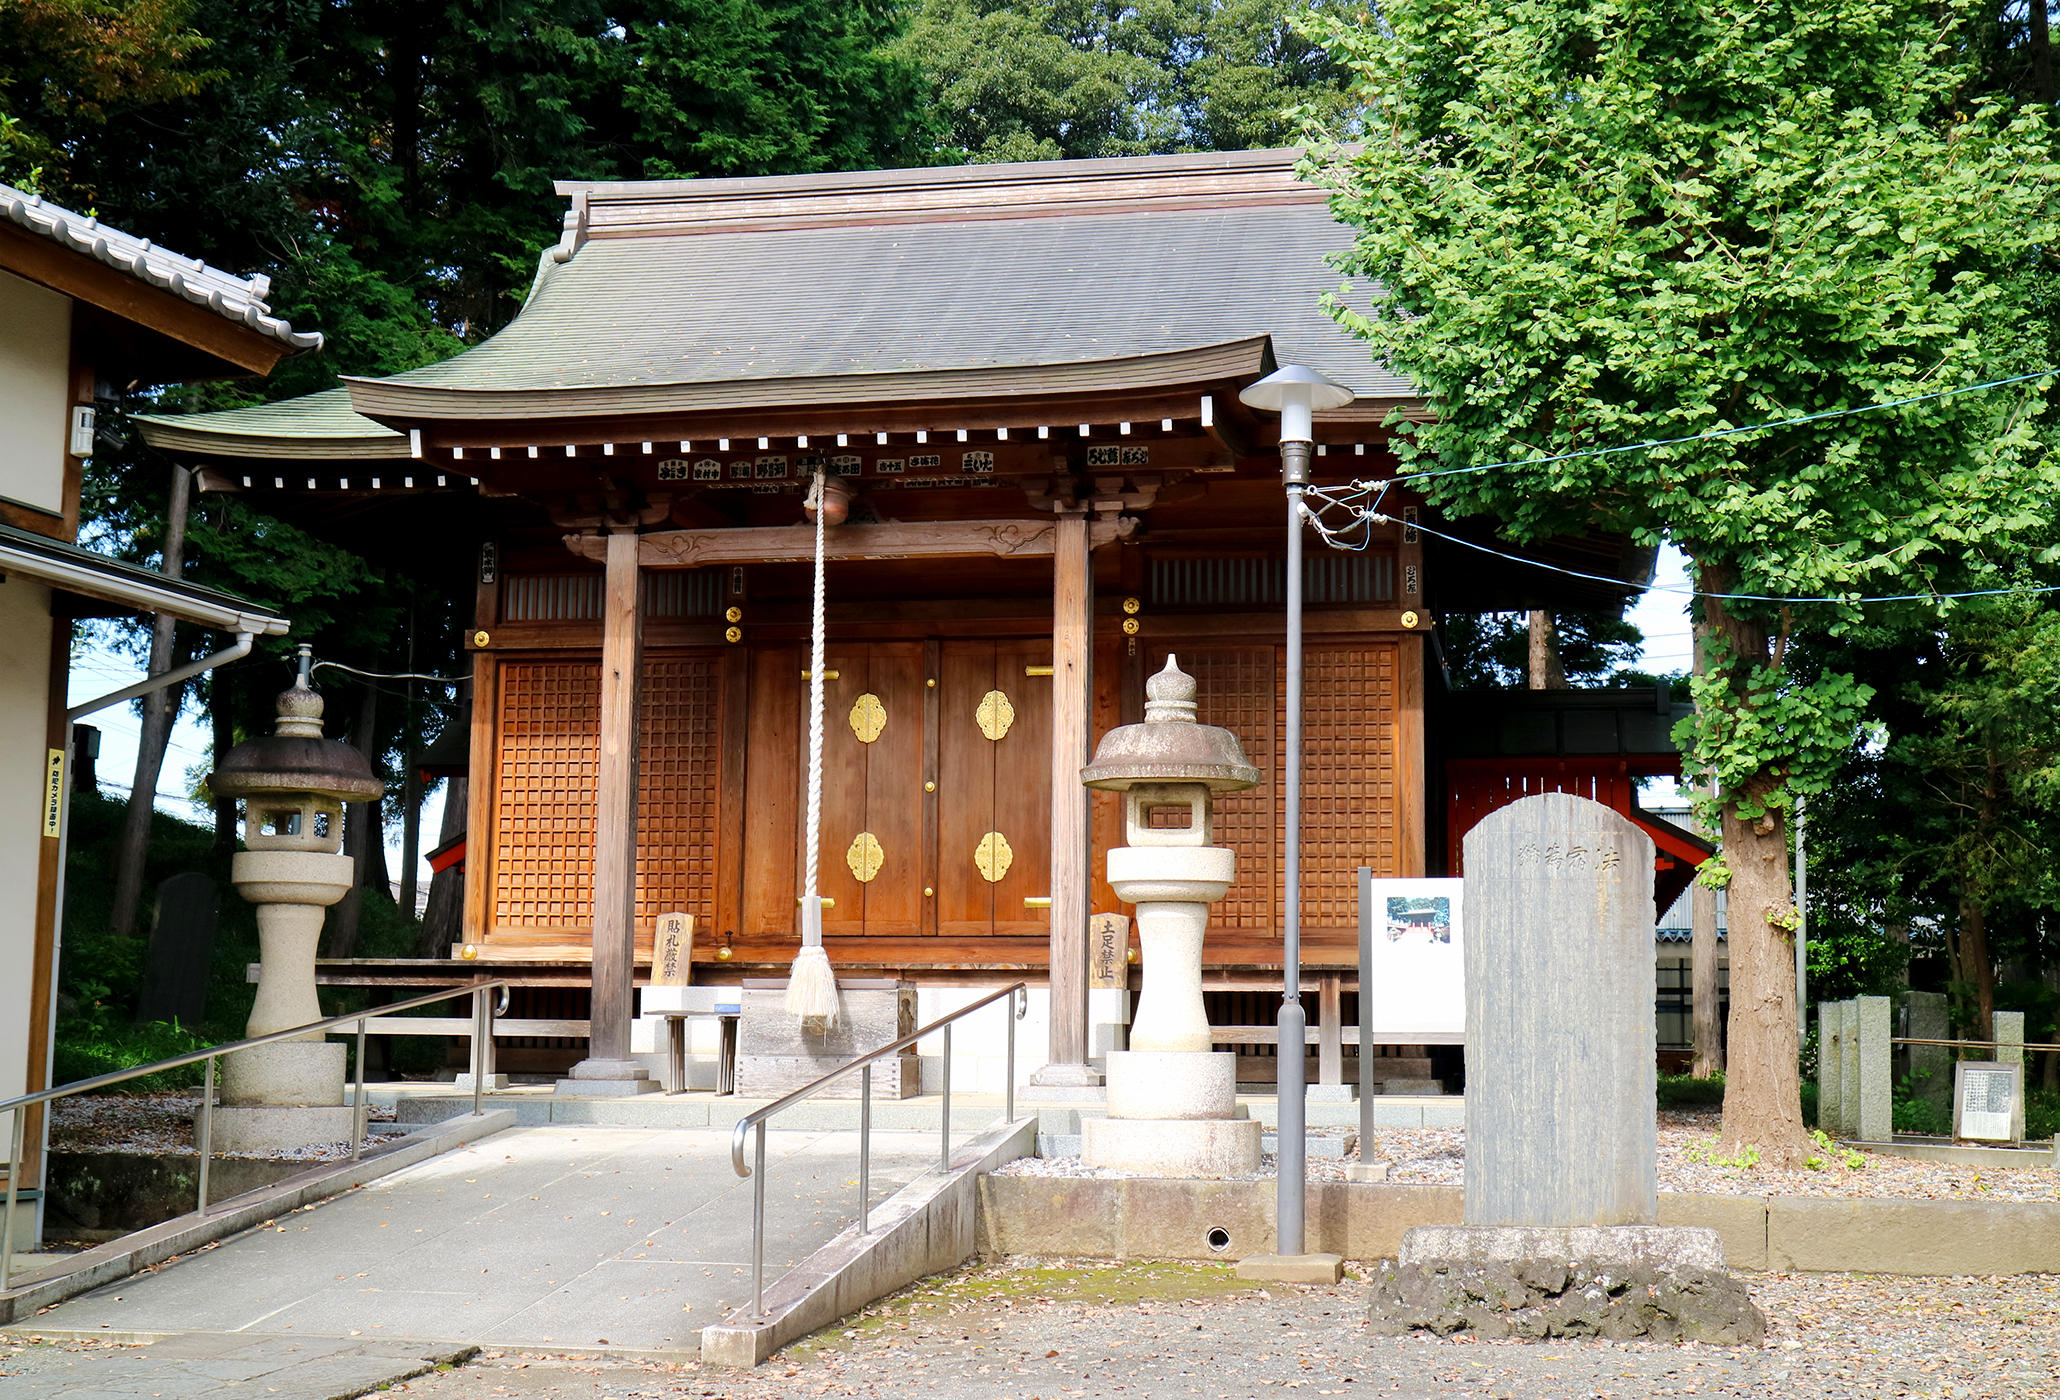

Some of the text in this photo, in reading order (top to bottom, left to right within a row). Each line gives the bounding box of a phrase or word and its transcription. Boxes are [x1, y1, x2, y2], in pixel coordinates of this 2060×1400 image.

[663, 919, 681, 977] 貼札厳禁
[1098, 920, 1116, 979] 土足禁止
